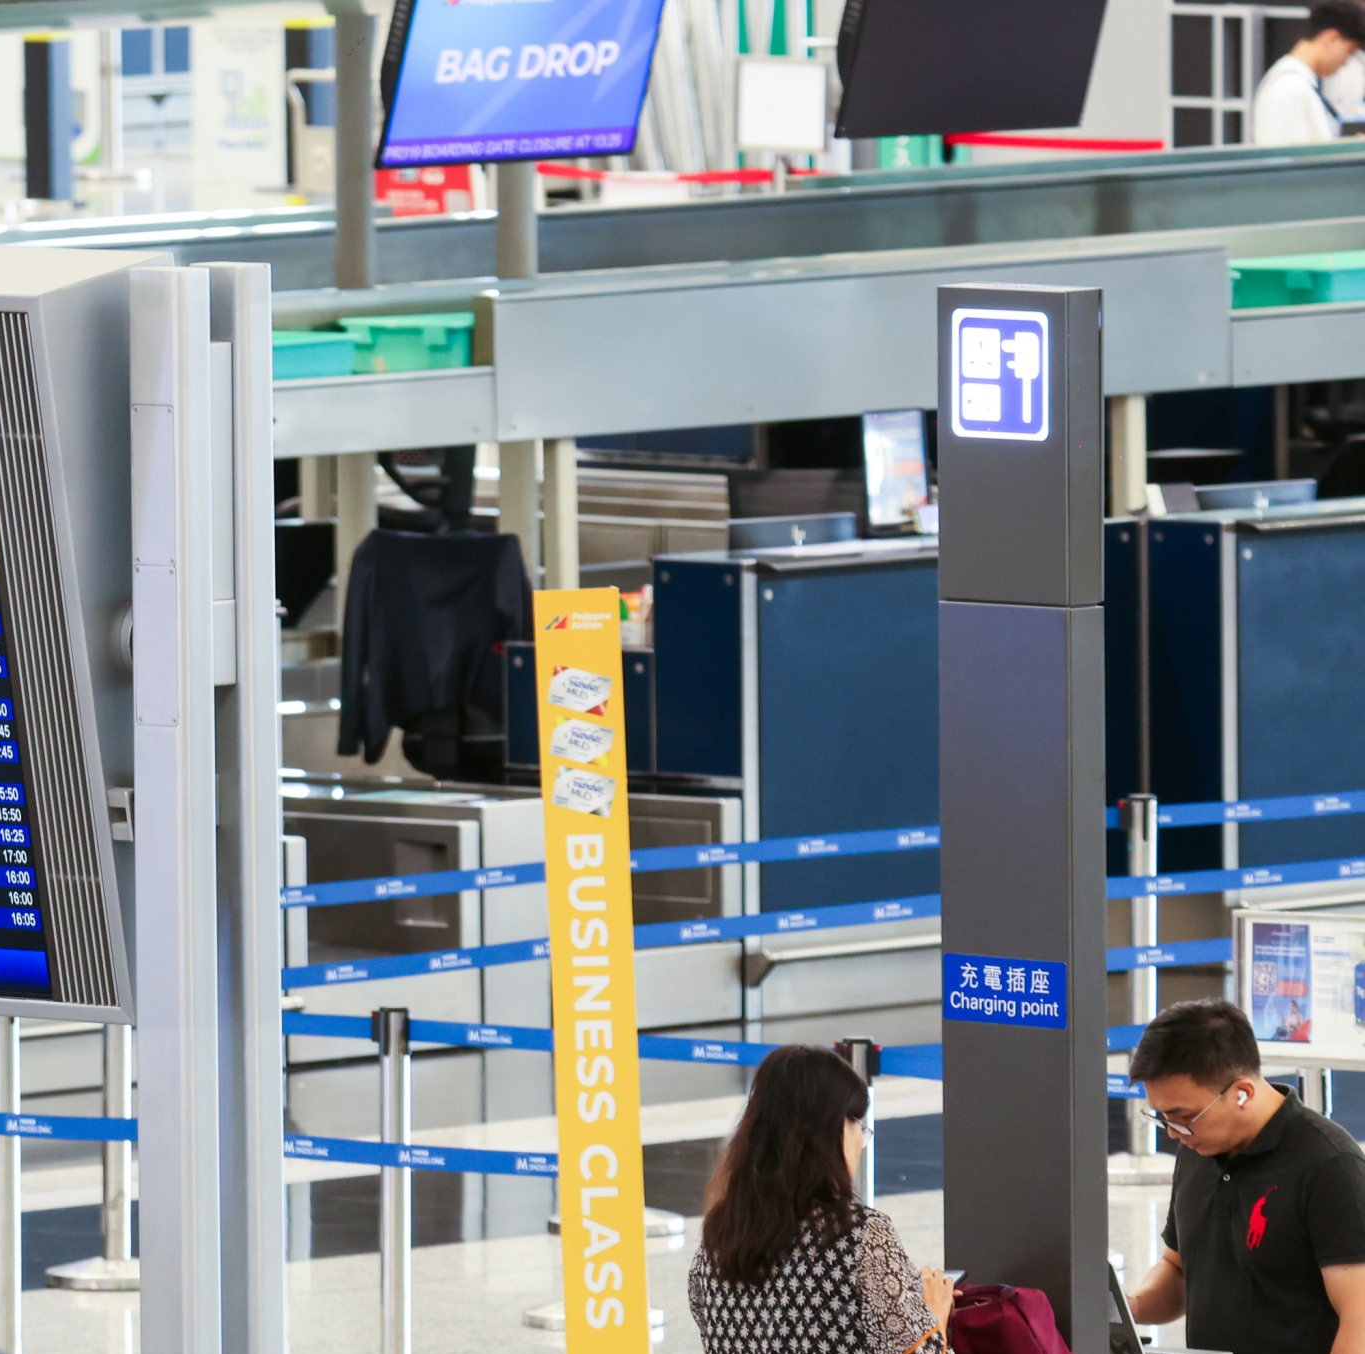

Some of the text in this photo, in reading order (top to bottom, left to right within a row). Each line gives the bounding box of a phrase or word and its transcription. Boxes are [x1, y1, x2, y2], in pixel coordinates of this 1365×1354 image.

[435, 40, 619, 84] BAG DROP
[6, 870, 30, 885] 16:00
[566, 834, 615, 1124] BUSINESS
[960, 962, 1049, 994] 充電插座
[950, 991, 1059, 1018] Charging point
[580, 1144, 624, 1328] CLASS
